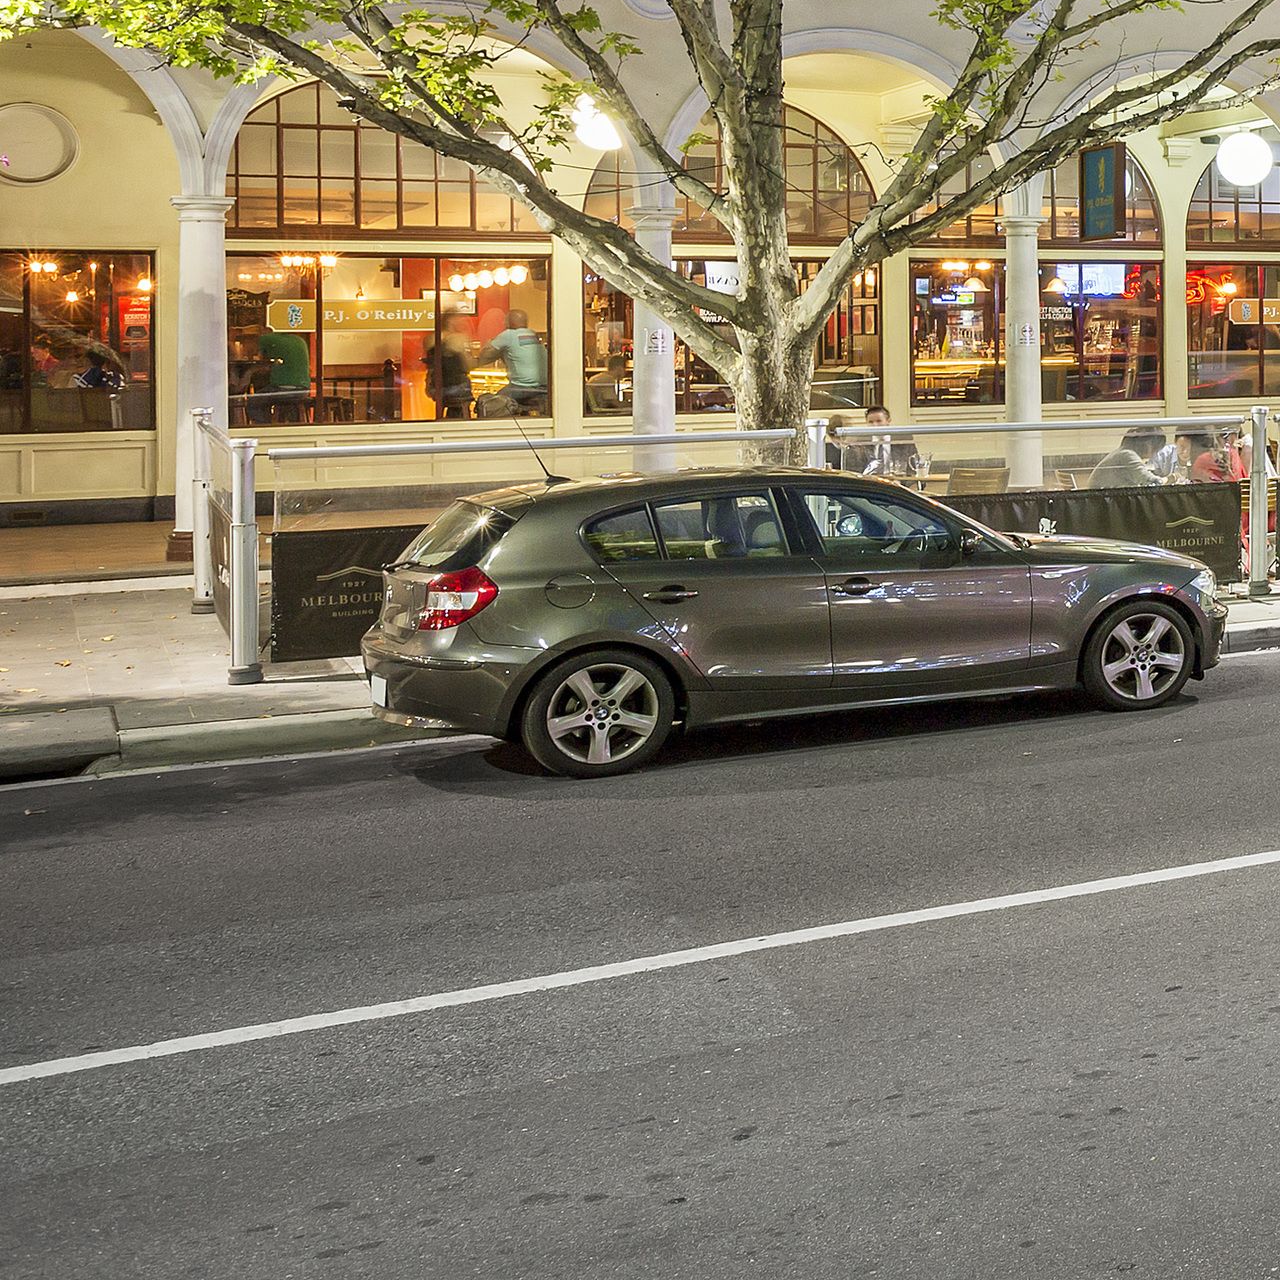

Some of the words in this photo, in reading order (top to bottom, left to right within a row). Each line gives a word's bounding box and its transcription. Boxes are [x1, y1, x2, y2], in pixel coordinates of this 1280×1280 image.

[324, 310, 350, 323] P.J.
[356, 309, 435, 322] O'Reilly's
[1263, 306, 1280, 318] P.J.
[1156, 536, 1225, 549] MELBOURNE
[342, 580, 366, 588] 1927
[301, 591, 383, 608] MELBOUR
[332, 608, 374, 617] BUILDING
